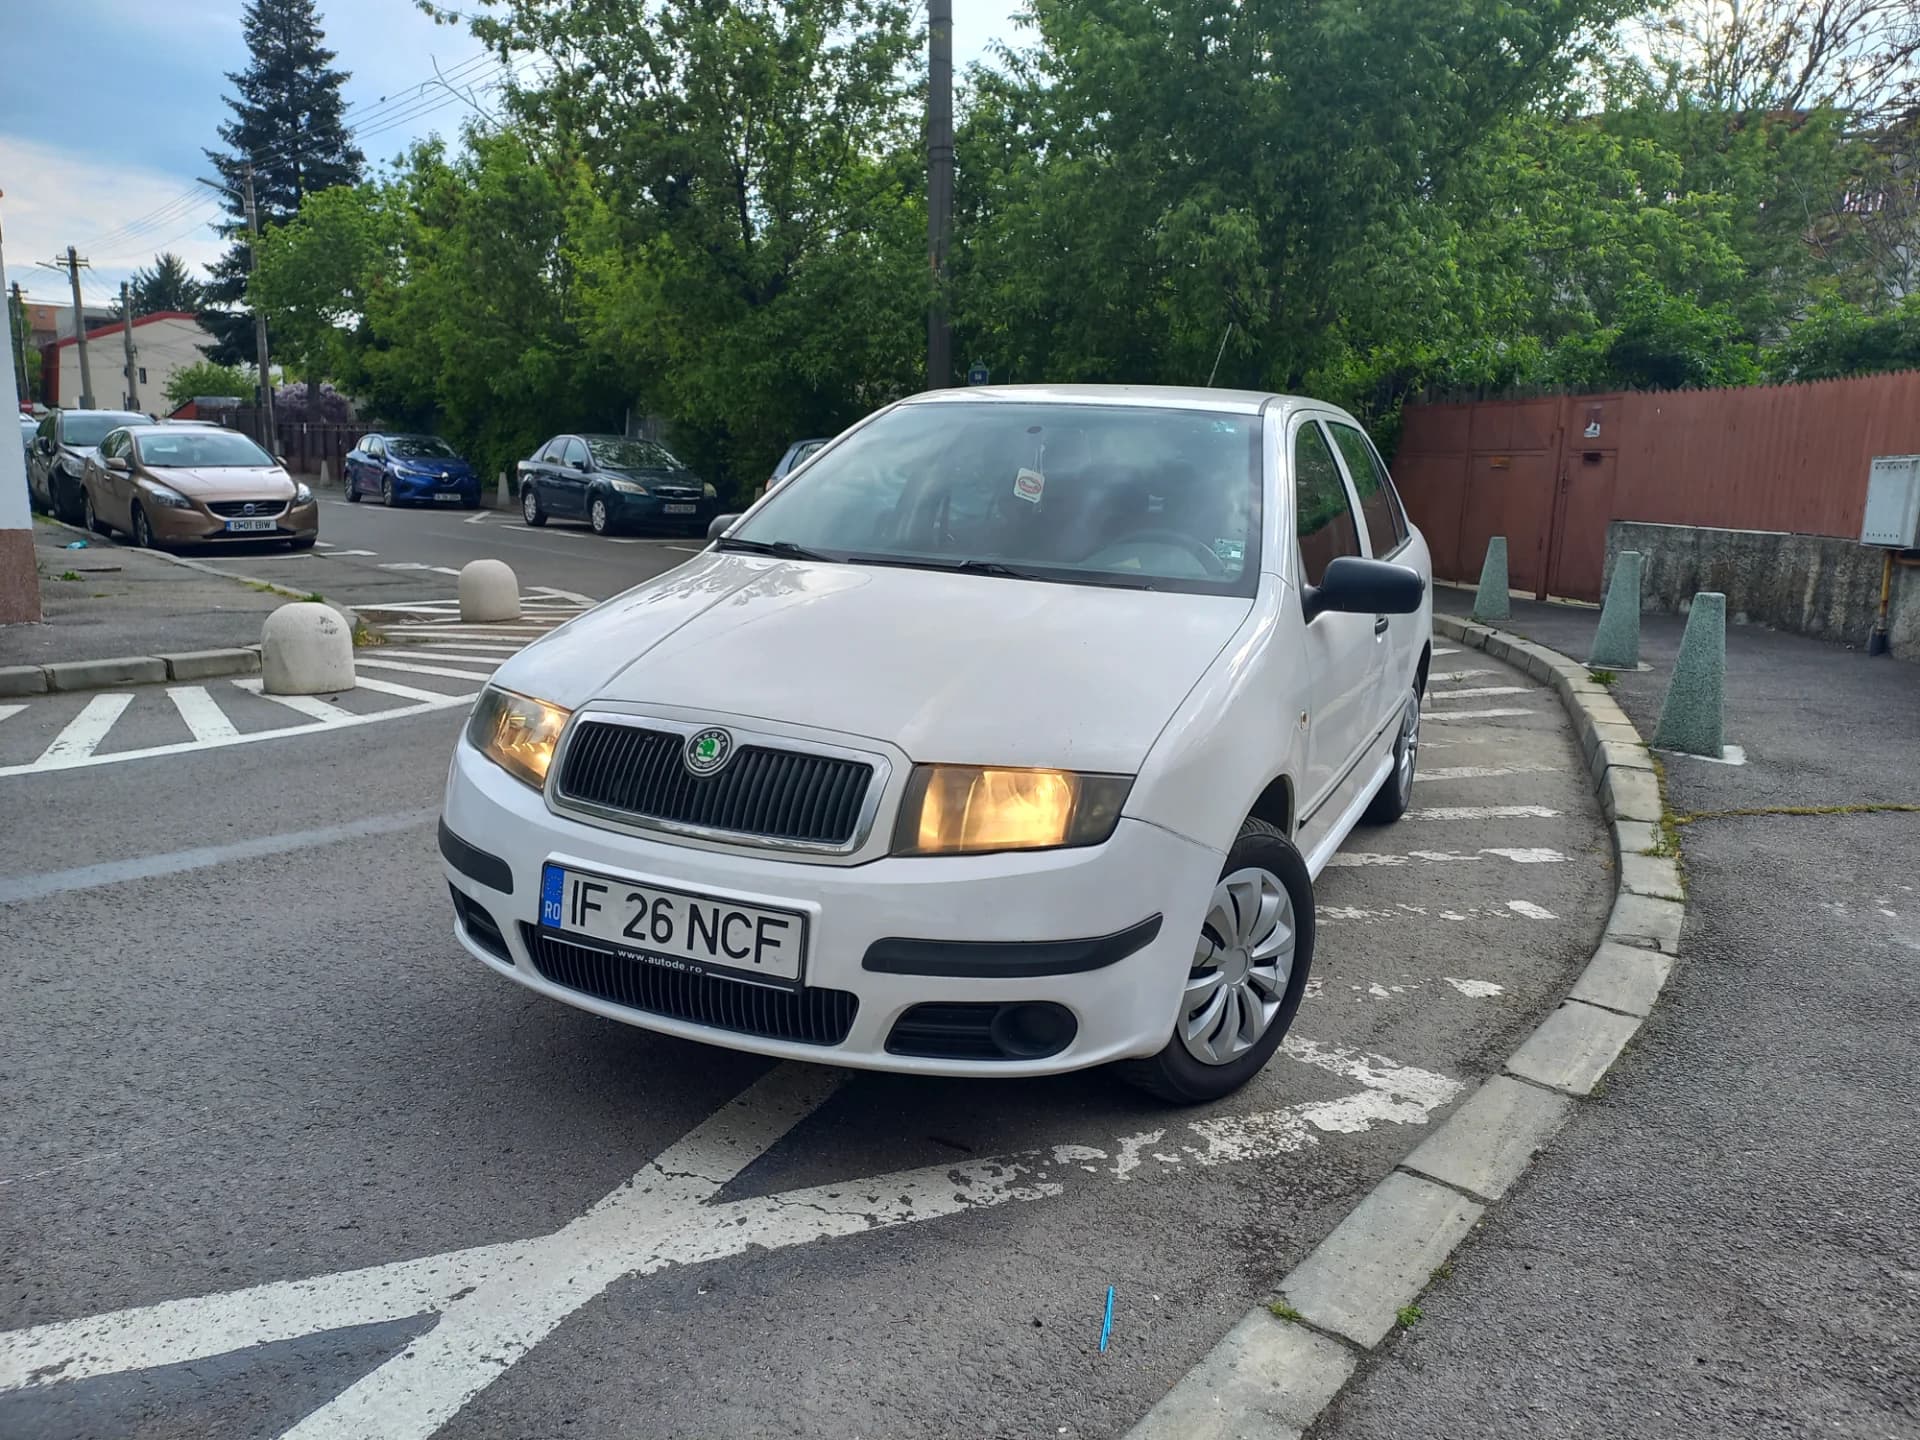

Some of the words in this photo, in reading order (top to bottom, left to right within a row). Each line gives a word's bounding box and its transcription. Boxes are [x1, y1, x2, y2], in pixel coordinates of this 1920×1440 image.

[544, 901, 560, 920] RO
[571, 880, 608, 927] IF
[623, 892, 674, 944] 26
[687, 903, 789, 964] NCF
[617, 950, 702, 973] www.autode.ro
